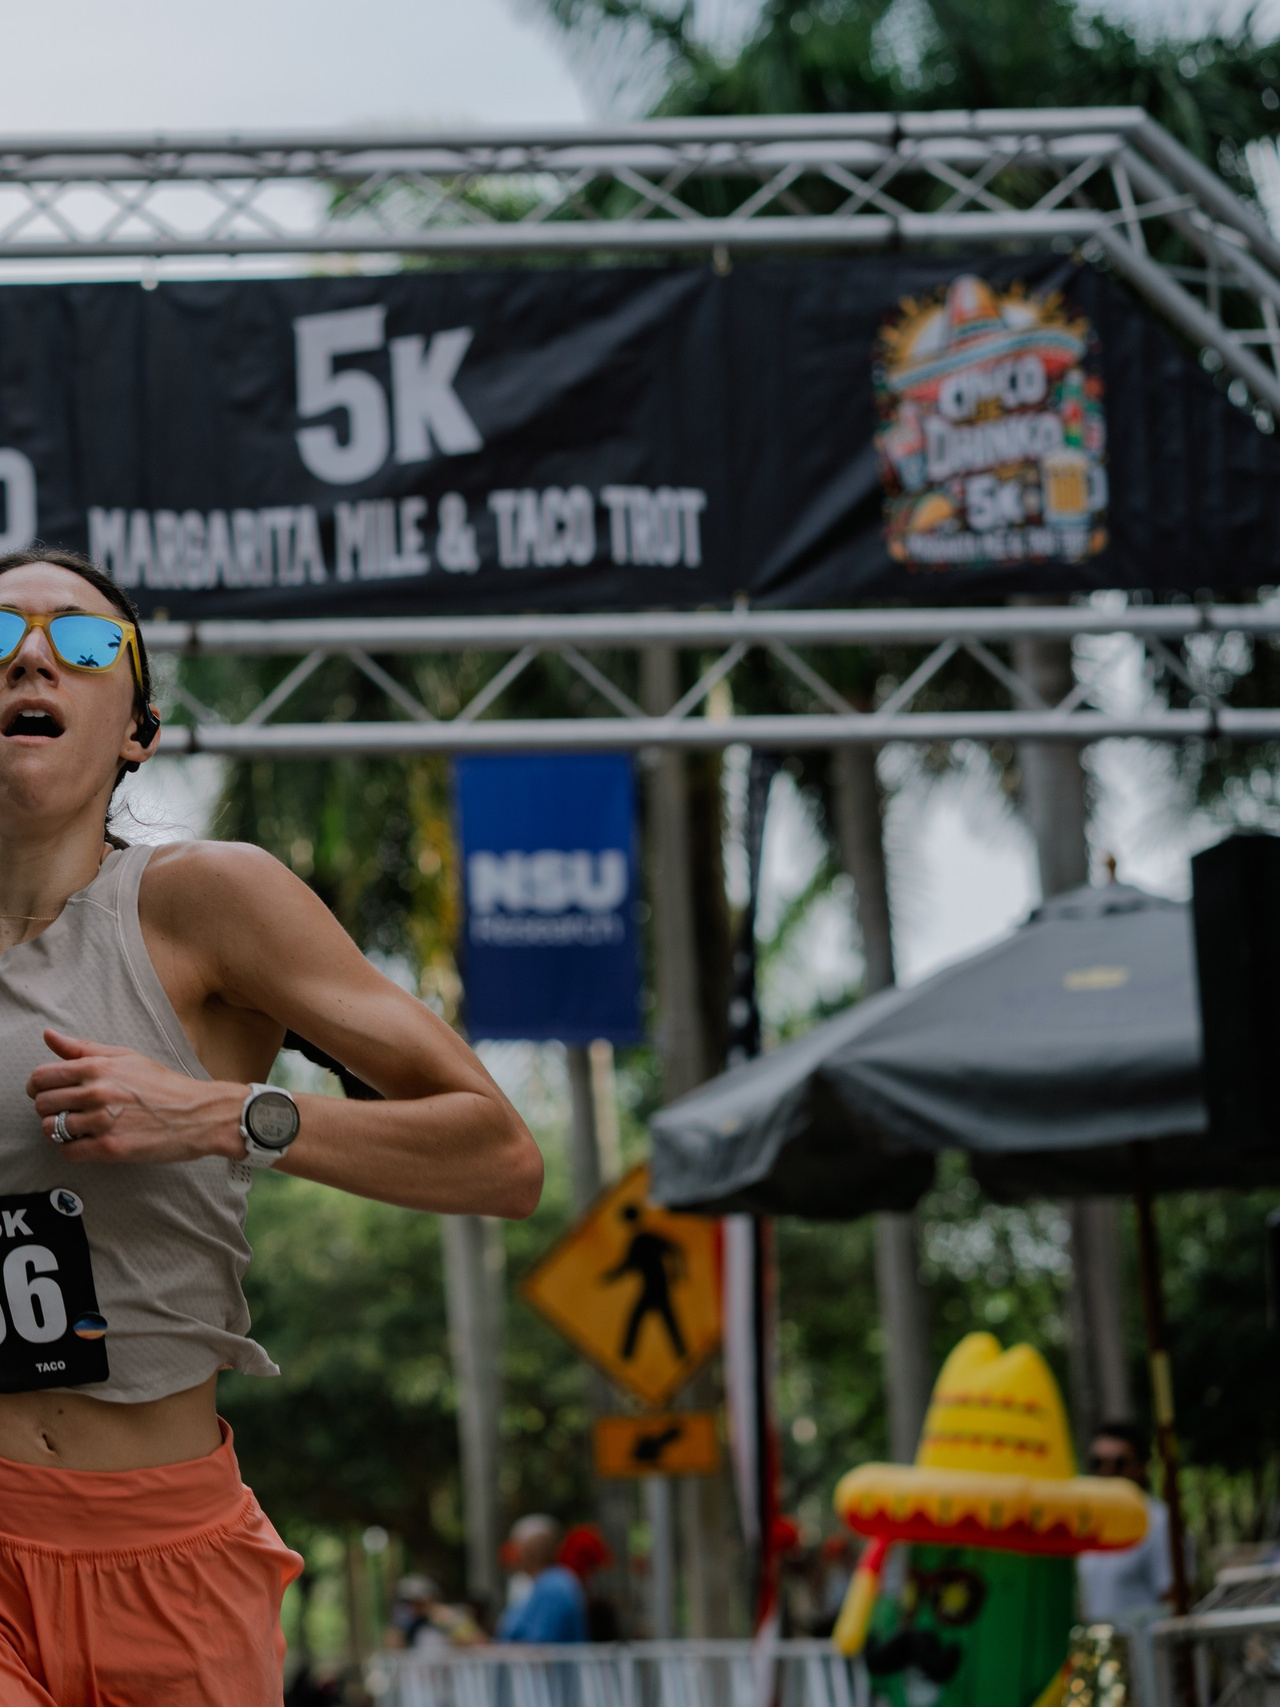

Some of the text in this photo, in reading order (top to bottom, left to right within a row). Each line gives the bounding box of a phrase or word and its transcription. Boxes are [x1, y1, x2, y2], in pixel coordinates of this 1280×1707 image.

[293, 304, 484, 485] 5K
[88, 485, 708, 591] MARGARITA MILE & TACO TROT
[469, 849, 627, 914] NSU
[35, 1360, 66, 1373] TACO
